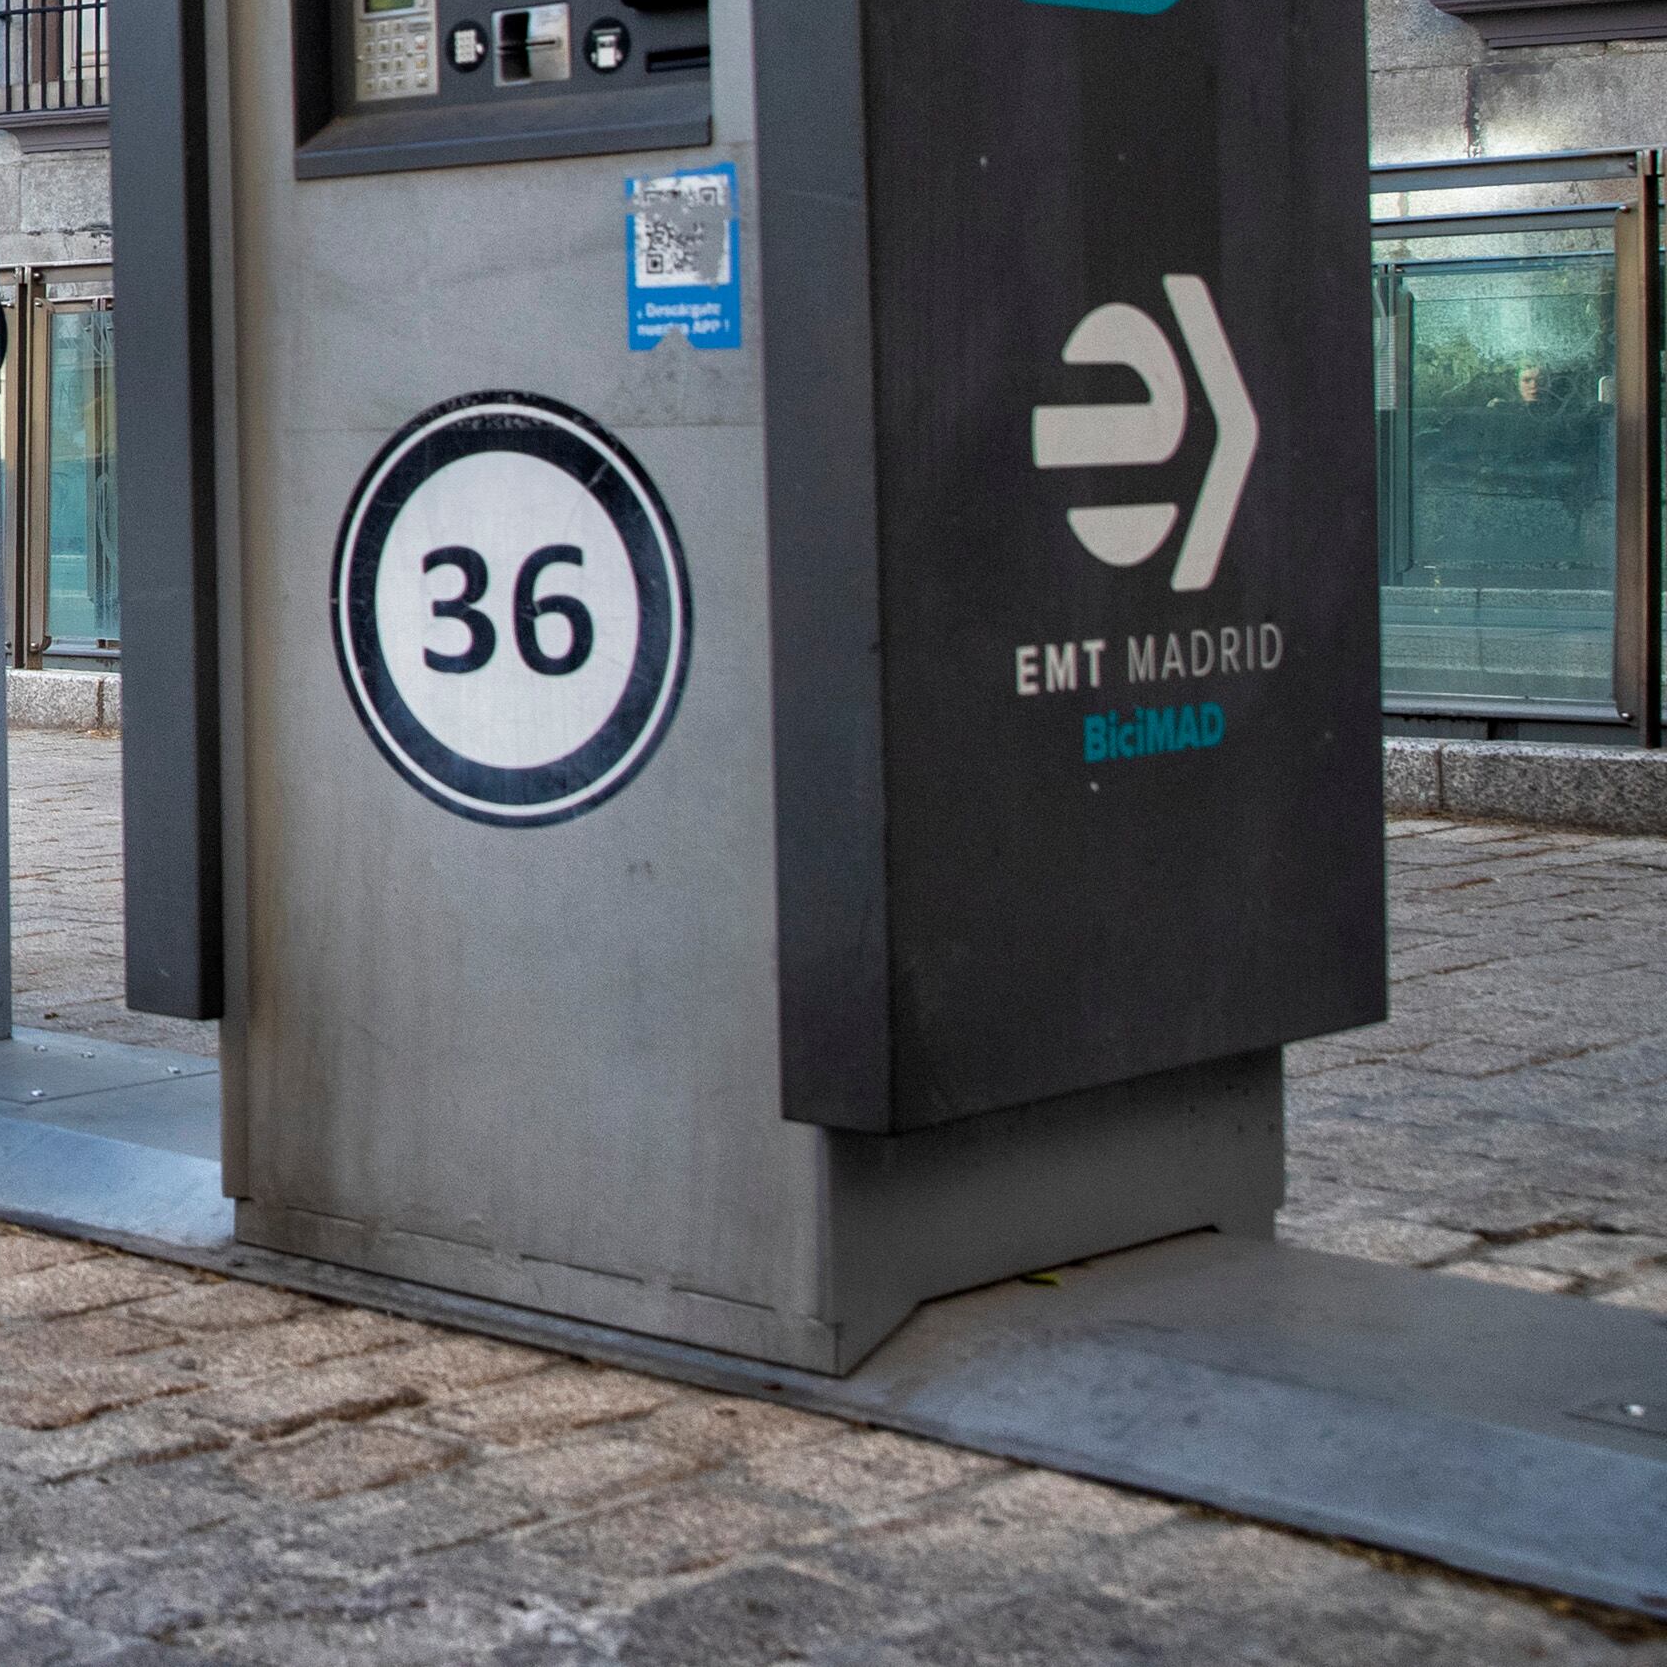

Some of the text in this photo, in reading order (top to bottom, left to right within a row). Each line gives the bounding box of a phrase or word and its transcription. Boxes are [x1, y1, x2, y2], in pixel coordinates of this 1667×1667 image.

[420, 543, 595, 677] 36
[1015, 621, 1284, 697] EMT MADRID
[1082, 700, 1227, 764] BiciMAD
